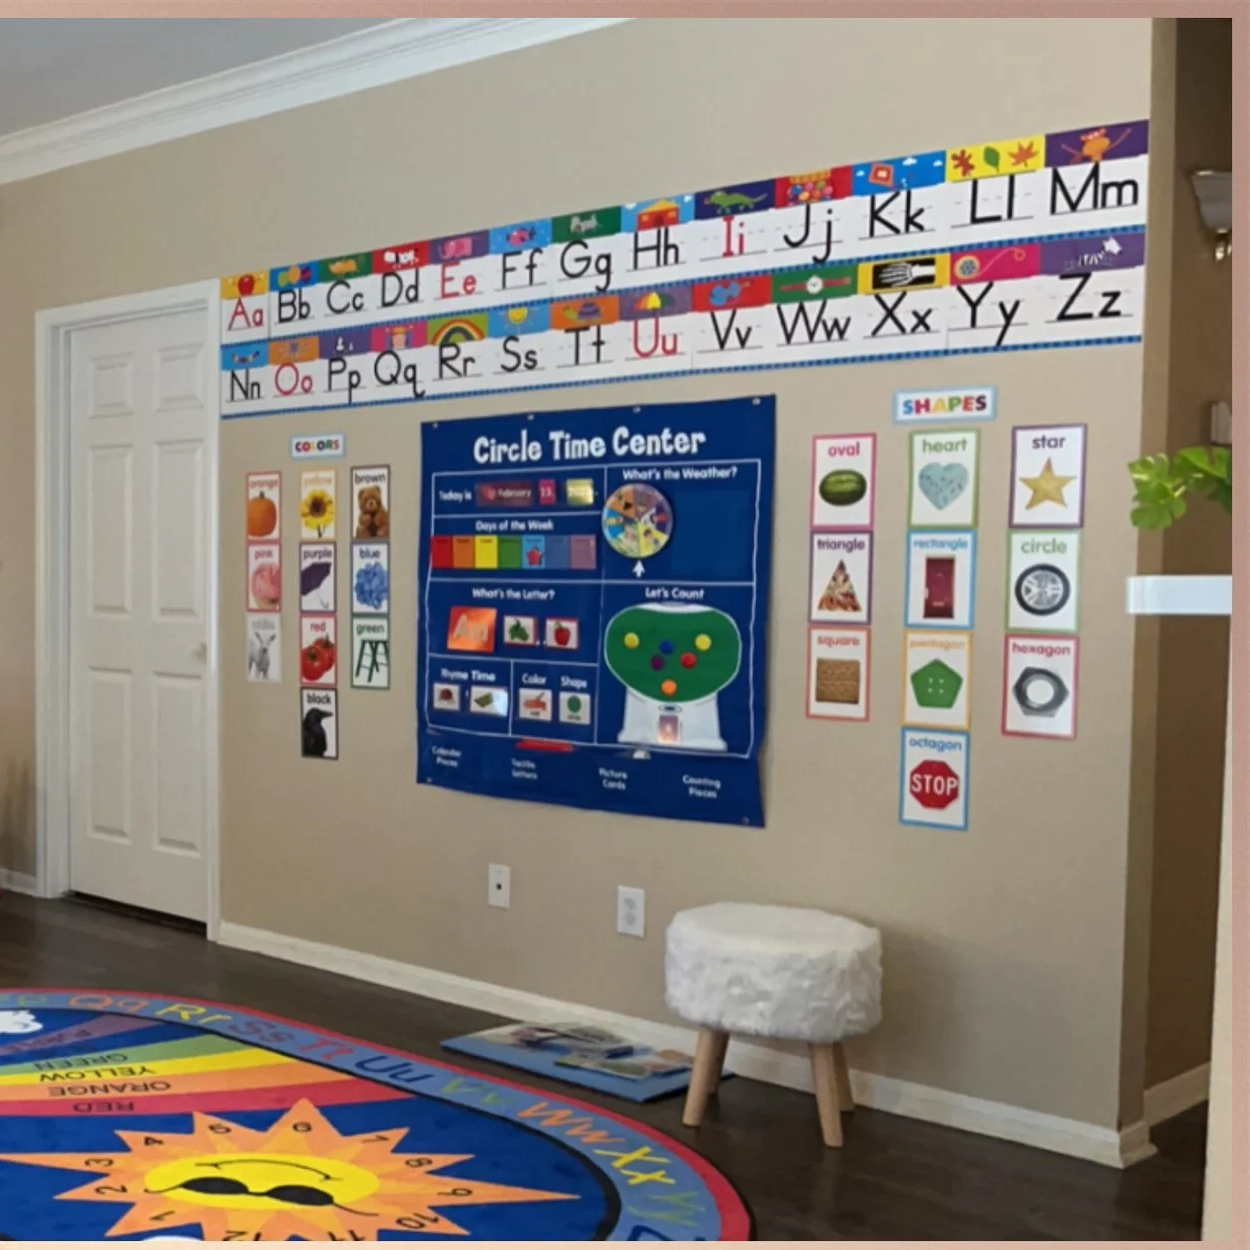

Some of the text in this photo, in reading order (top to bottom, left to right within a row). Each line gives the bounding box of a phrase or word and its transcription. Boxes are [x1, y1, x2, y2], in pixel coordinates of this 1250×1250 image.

[228, 162, 1139, 330] Aa Bb Cc Dd Ee Ff Gg Hh Ii Jj Kk Ll Mm
[229, 274, 1121, 402] Nn Oo Pp Qq Rr Ss Tt Uu Vv Ww Xx Yy Zz
[903, 395, 987, 415] SHAPES
[474, 426, 706, 464] Circle Time Center
[922, 438, 967, 454] heart
[1032, 436, 1066, 449] star
[828, 442, 860, 458] oval
[355, 474, 386, 484] brown
[623, 466, 737, 481] What's the Weather?
[498, 488, 531, 499] February
[475, 520, 553, 532] Days of the Week
[818, 539, 865, 552] triangle
[914, 538, 968, 550] rectangle
[1020, 538, 1067, 554] circle
[255, 549, 273, 560] pink
[304, 549, 332, 560] purple
[359, 548, 380, 559] blue
[472, 588, 555, 600] What's the Letter?
[646, 587, 704, 600] Let's Count
[310, 621, 326, 632] red
[356, 623, 384, 636] green
[818, 636, 860, 648] square
[1012, 642, 1070, 656] hexagon
[471, 670, 495, 682] Time
[522, 674, 546, 685] Color
[561, 676, 587, 689] Shape
[307, 693, 331, 705] black
[910, 738, 962, 752] octagon
[683, 774, 721, 790] Counting
[910, 774, 958, 795] STOP
[39, 1065, 158, 1083] YELLOW
[51, 1080, 172, 1097] ORANGE
[154, 1003, 233, 1023] Rr
[355, 1055, 435, 1082] Uu
[593, 1146, 676, 1185] Xx
[73, 1101, 135, 1112] RED
[85, 1157, 114, 1167] 3
[405, 1157, 434, 1168] 8
[96, 1184, 128, 1195] 2
[396, 1212, 439, 1229] 10
